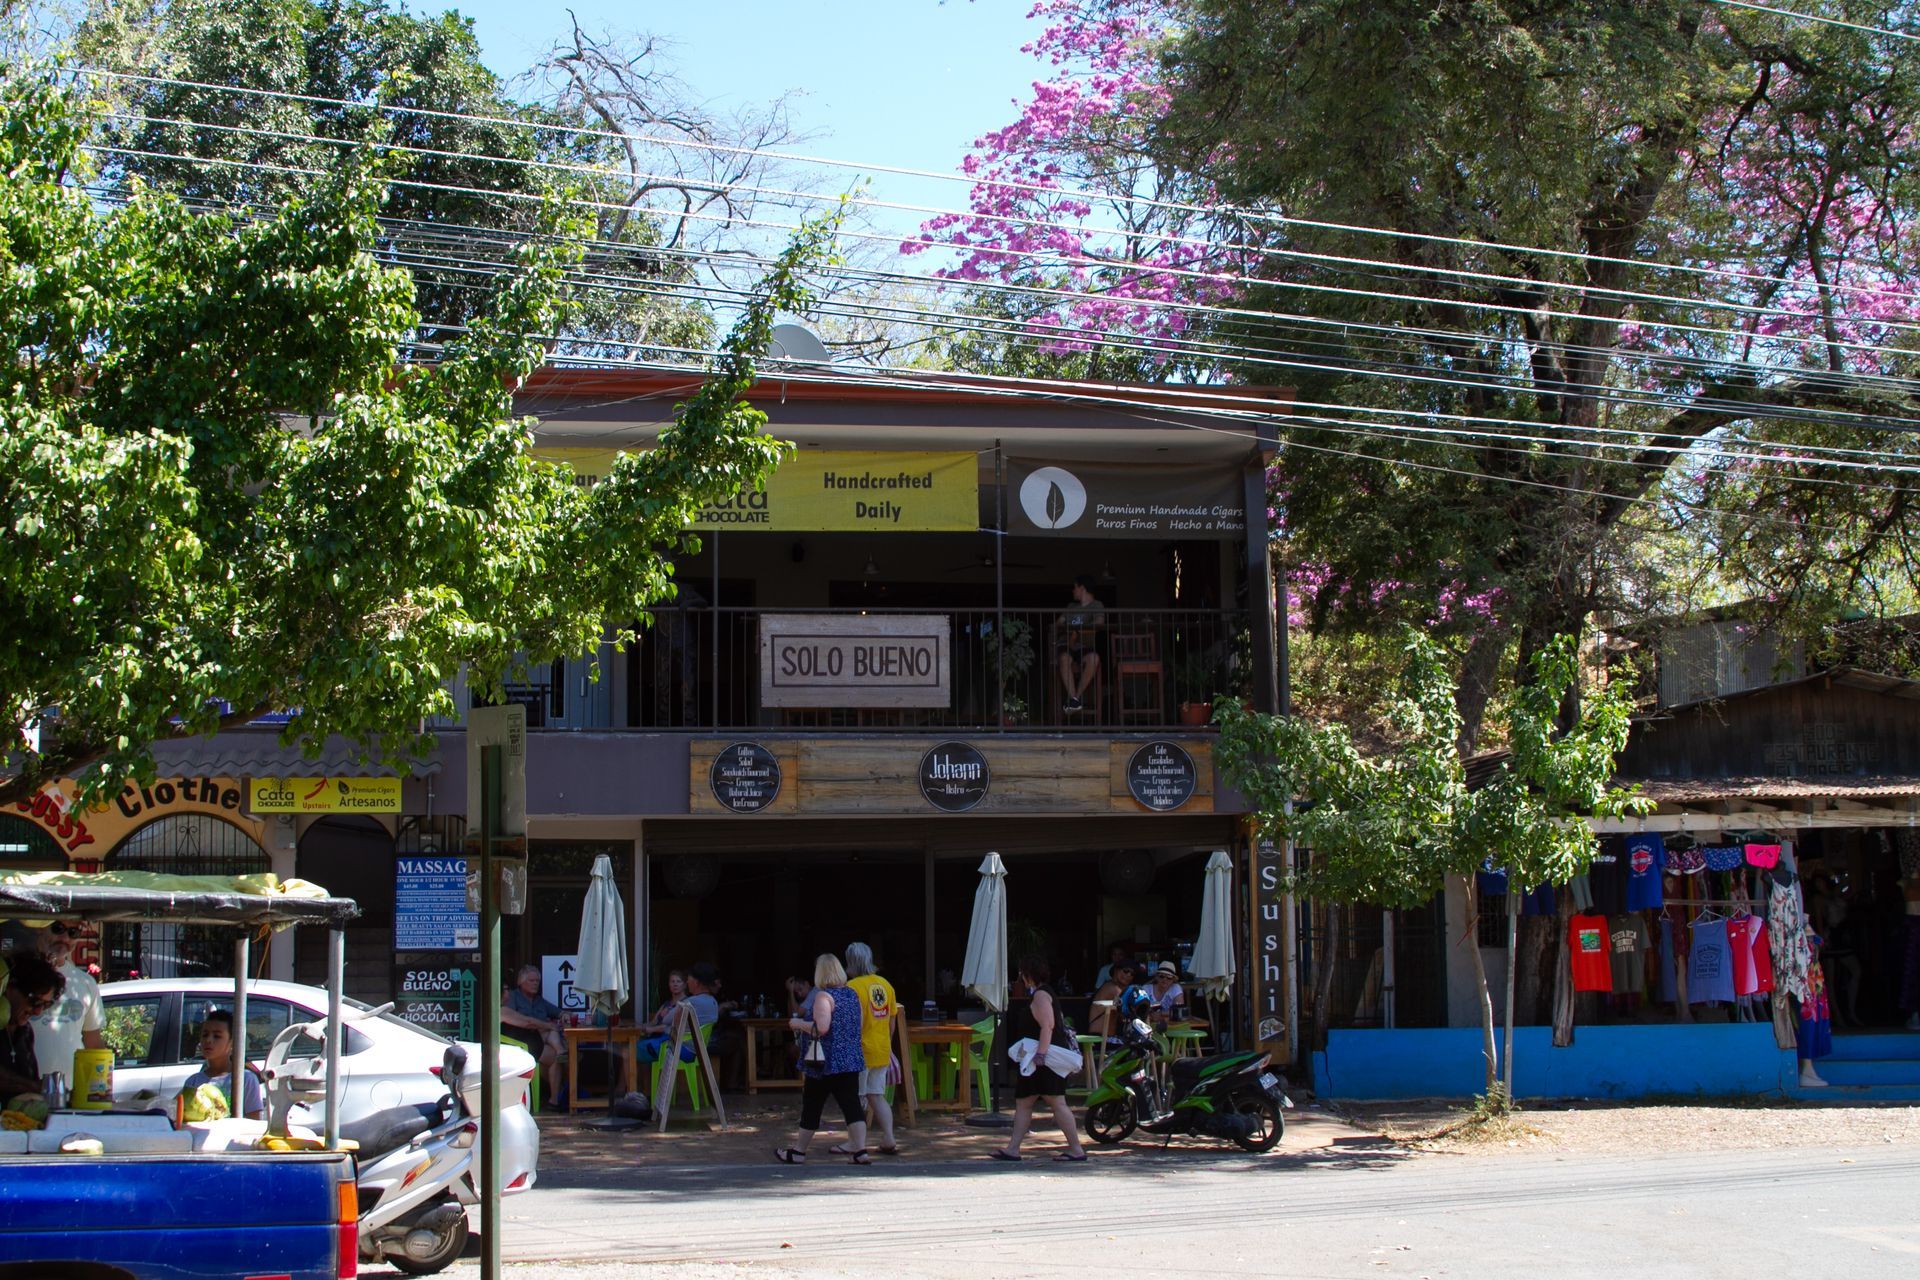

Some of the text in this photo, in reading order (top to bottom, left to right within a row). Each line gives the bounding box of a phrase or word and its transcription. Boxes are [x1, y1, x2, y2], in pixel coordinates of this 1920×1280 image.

[824, 472, 932, 489] Handcrafted
[695, 511, 770, 523] CHOCOLATE
[856, 501, 901, 522] Daily
[1096, 504, 1244, 518] Premium Handmade Cigars
[1096, 518, 1126, 529] Puros
[1130, 519, 1157, 529] Finos
[1169, 519, 1202, 530] Hecho
[1216, 521, 1244, 530] Mano
[781, 645, 932, 677] SOLO BUENO
[738, 757, 753, 767] Salad
[929, 754, 981, 780] Johann
[116, 777, 243, 818] Clothe
[257, 784, 295, 801] Cata
[351, 786, 396, 795] Premium Cigars
[302, 802, 331, 810] Upstairs
[339, 796, 396, 808] Artesanos
[398, 860, 467, 874] MASSAG
[1260, 865, 1280, 1013] Sushi
[405, 970, 448, 981] SOLO
[403, 980, 452, 991] BUENO
[406, 1003, 444, 1012] CATA
[462, 980, 472, 1038] UPSTAI
